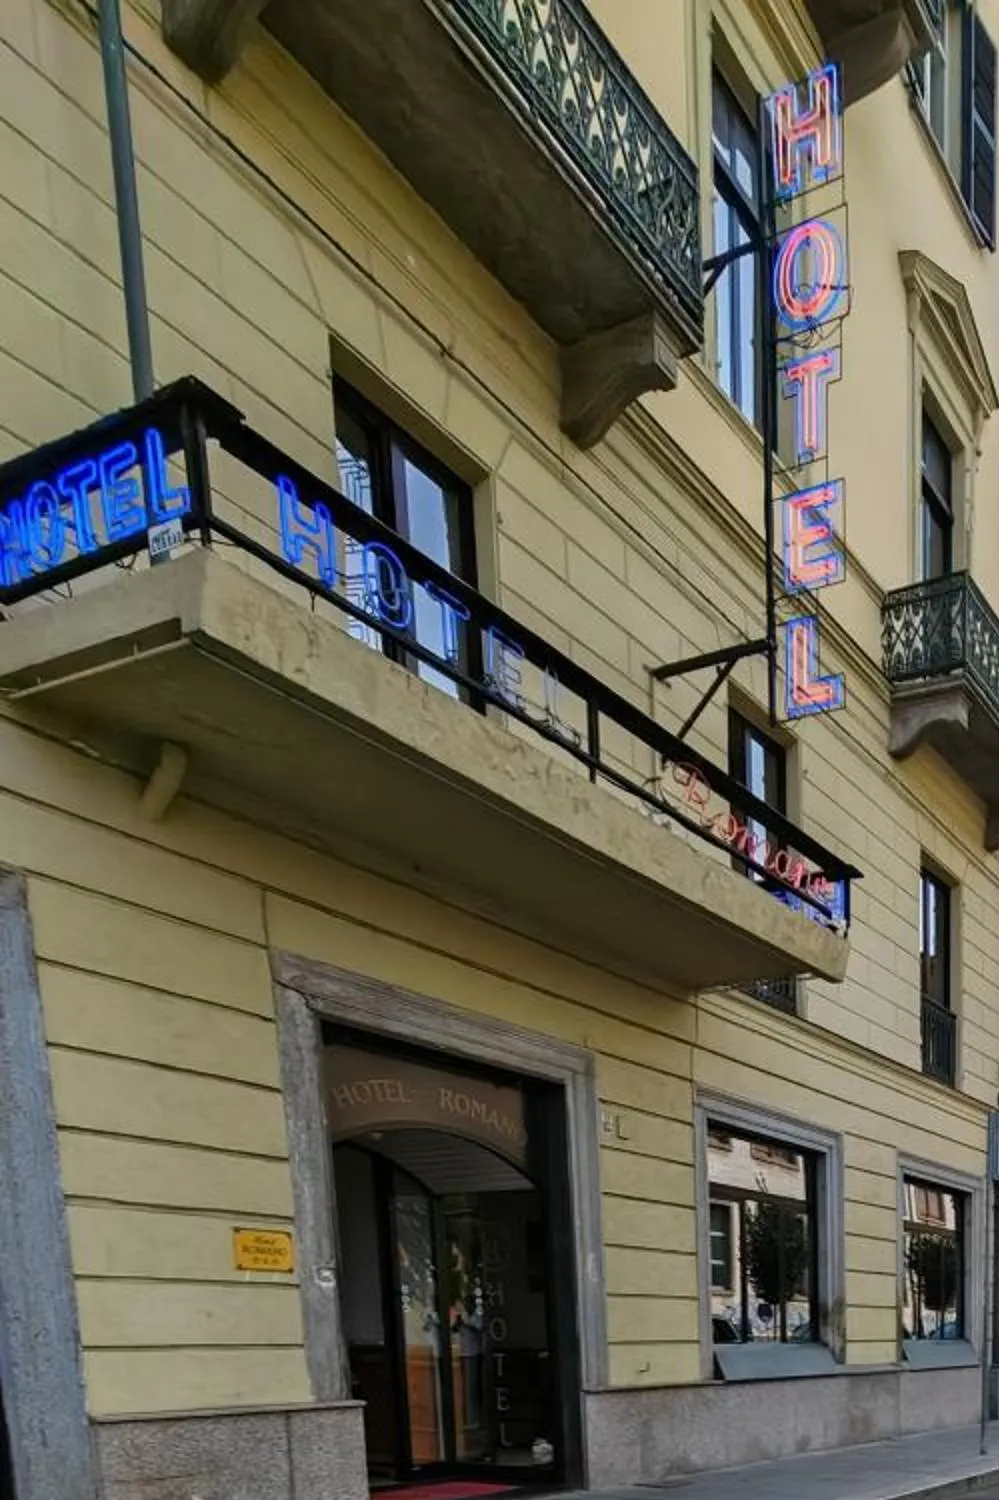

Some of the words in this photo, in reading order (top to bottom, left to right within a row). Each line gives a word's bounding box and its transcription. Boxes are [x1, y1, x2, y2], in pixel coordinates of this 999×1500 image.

[769, 61, 846, 719] HOTEL
[0, 427, 192, 588] HOTEL
[277, 474, 582, 749] HOTEL
[332, 1078, 413, 1107] HOTEL
